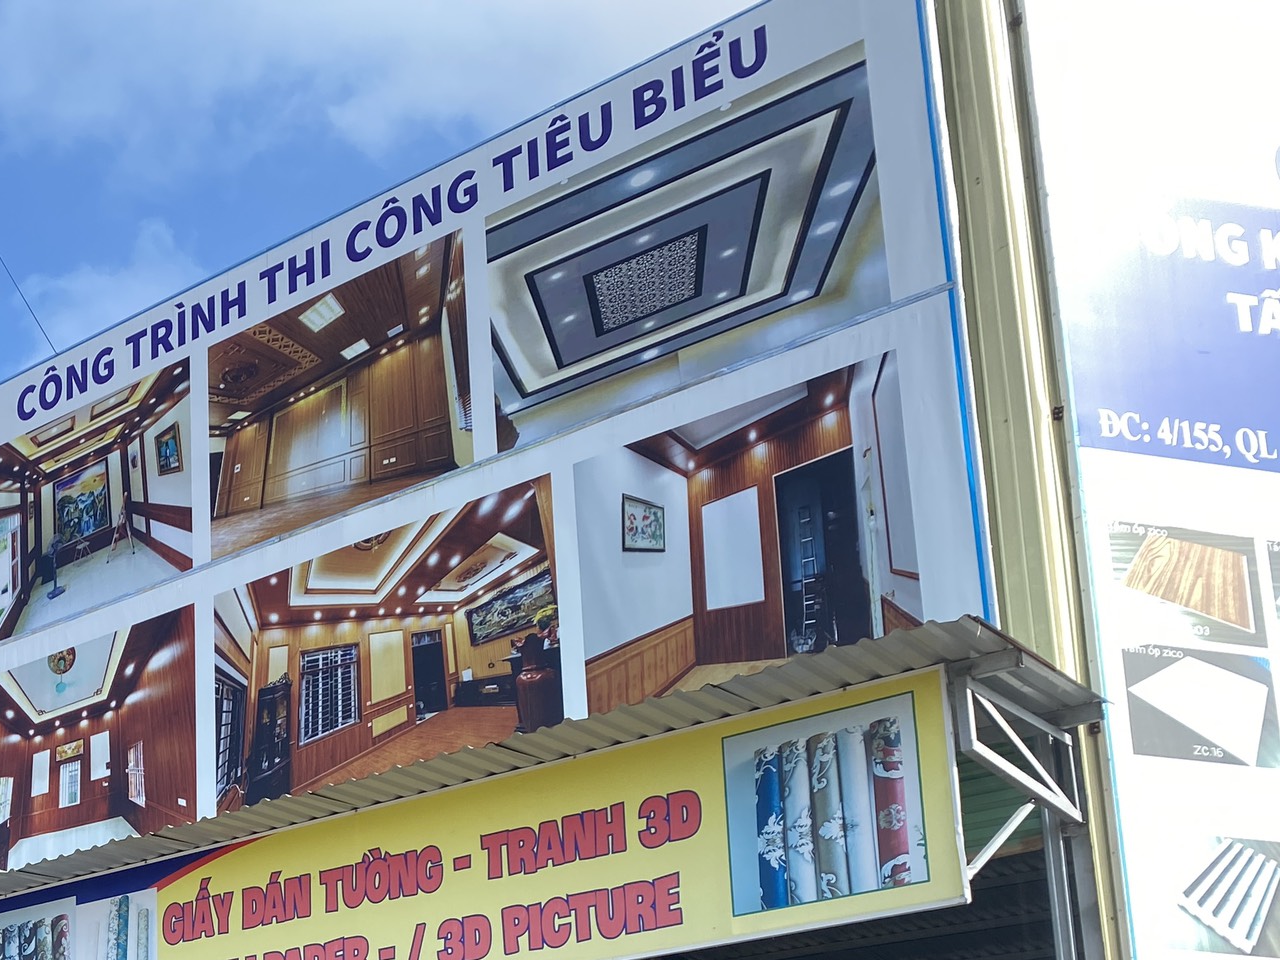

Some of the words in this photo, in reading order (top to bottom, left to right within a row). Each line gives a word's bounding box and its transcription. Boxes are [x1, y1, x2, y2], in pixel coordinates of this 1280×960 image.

[16, 325, 114, 422] CÔNG
[124, 281, 249, 370] TRÌNH
[258, 242, 331, 305] THI
[346, 170, 479, 264] CÔNG
[492, 102, 614, 192] TIÊU
[634, 24, 768, 129] BIỂU
[1097, 408, 1151, 444] ĐC:
[1157, 417, 1231, 459] 4/155,
[1235, 428, 1278, 463] QL
[162, 876, 233, 946] GIẤY
[241, 870, 312, 931] DÁN
[320, 845, 444, 914] TƯỜNG
[480, 801, 627, 881] TRANH
[637, 789, 702, 849] 3D
[501, 871, 684, 958] PICTURE
